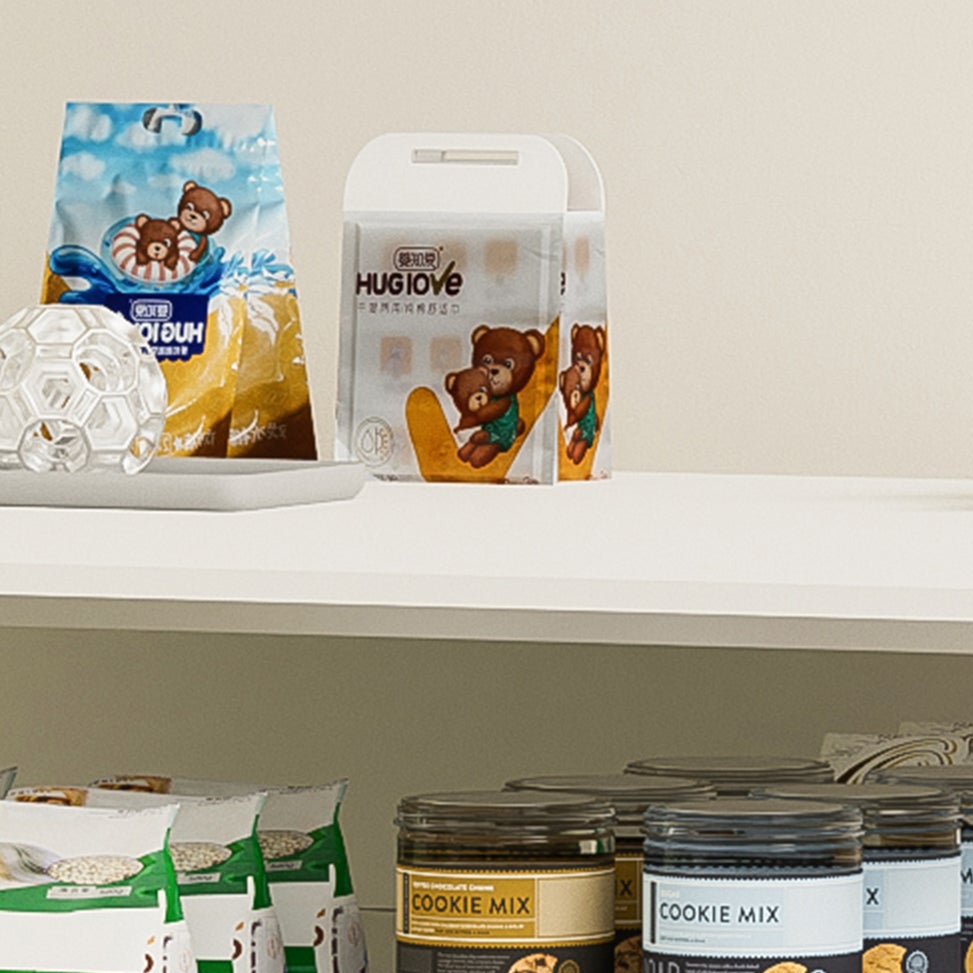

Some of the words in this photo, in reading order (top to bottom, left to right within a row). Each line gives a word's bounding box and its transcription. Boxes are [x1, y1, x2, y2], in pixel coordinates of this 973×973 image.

[412, 893, 482, 914] COOKIE
[489, 898, 530, 914] MIX
[659, 902, 731, 923] COOKIE
[738, 905, 779, 923] MIX
